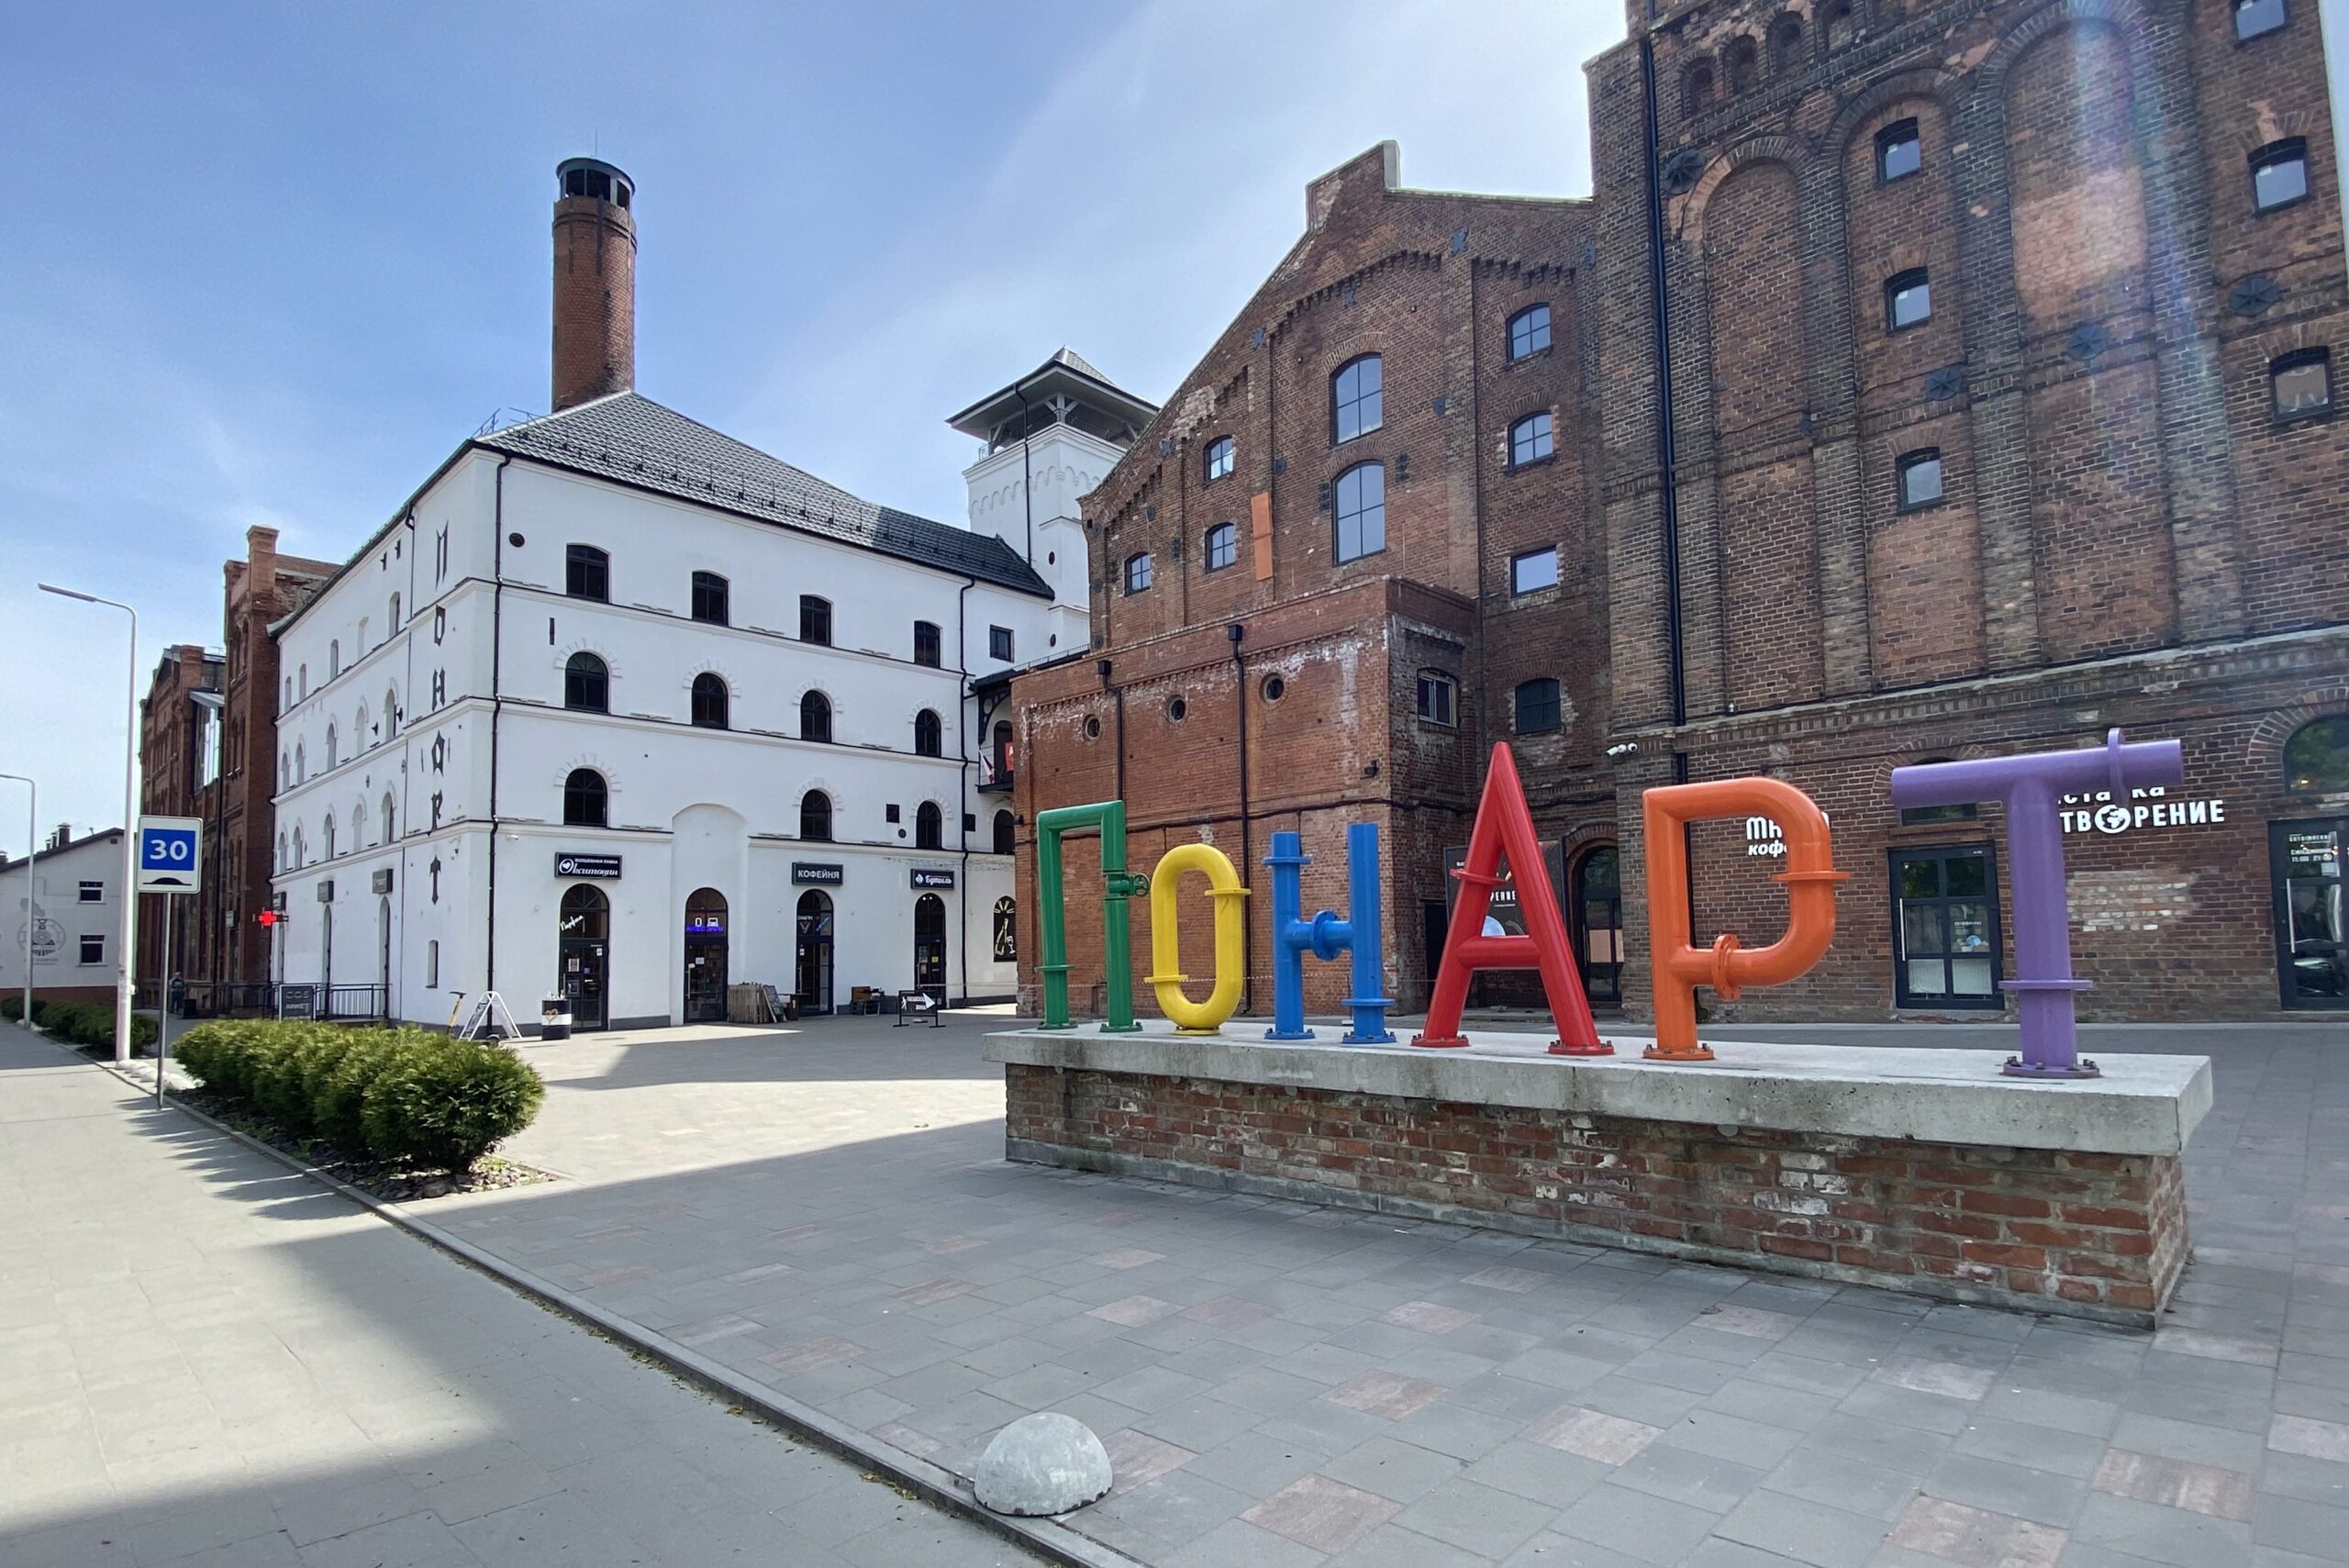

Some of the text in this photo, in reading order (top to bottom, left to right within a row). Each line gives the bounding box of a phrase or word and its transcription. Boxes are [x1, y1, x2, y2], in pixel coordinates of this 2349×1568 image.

[2059, 799, 2224, 834] ТВОРЕНИЕ
[150, 839, 188, 861] 30
[1748, 840, 1787, 858] коф
[797, 870, 840, 879] КОФЕЙНЯ
[1034, 727, 2182, 1079] ПОНАРТ
